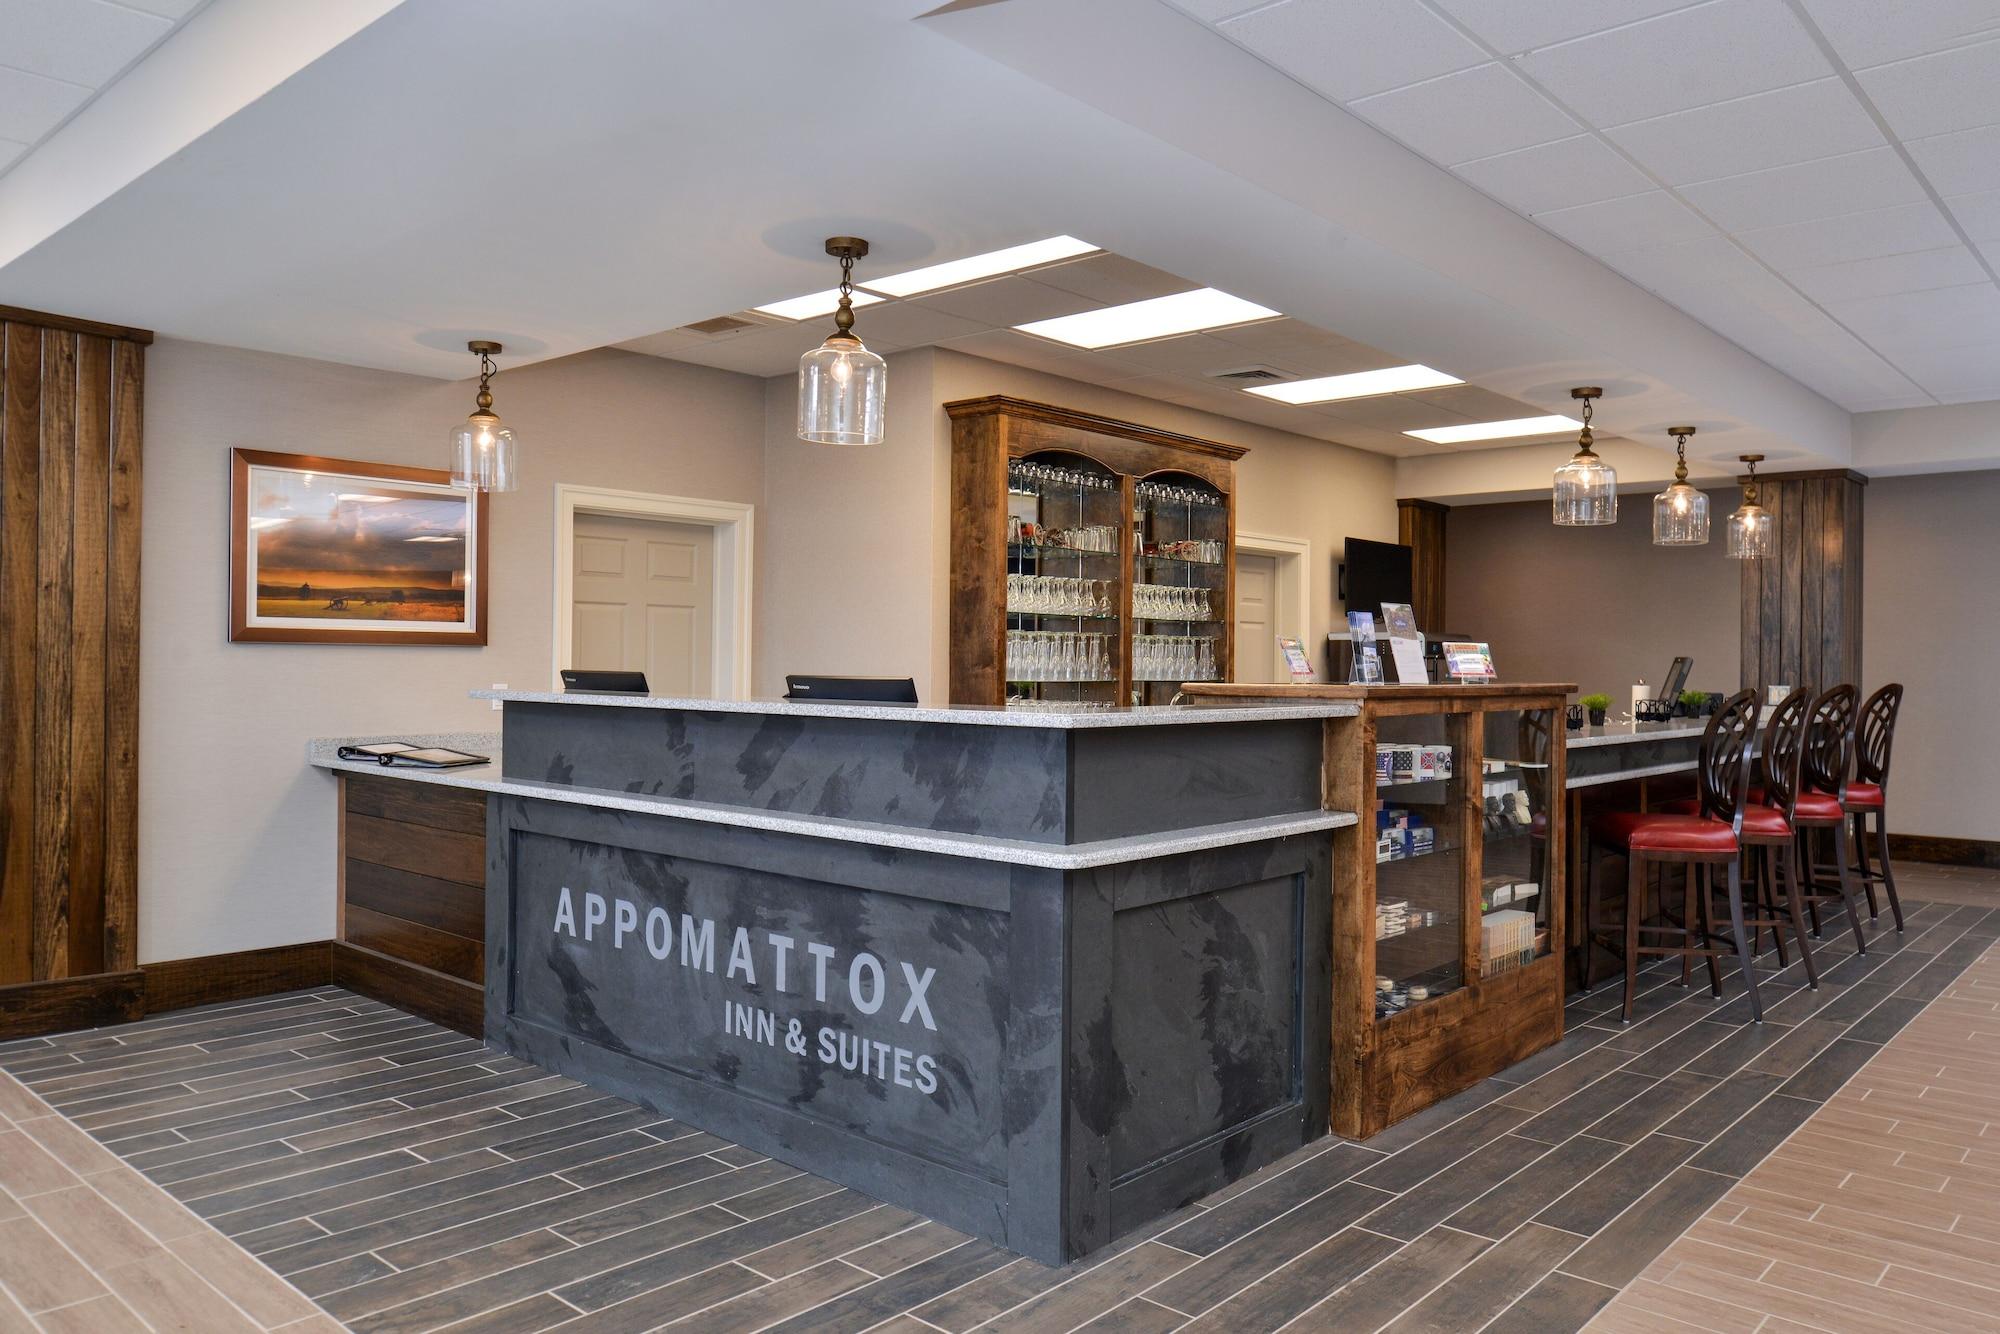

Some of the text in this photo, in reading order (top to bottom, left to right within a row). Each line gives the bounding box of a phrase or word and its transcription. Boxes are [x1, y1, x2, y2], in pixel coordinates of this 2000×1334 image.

[553, 887, 937, 1031] APPOMATTOX
[725, 1000, 938, 1095] INN & SUITES
